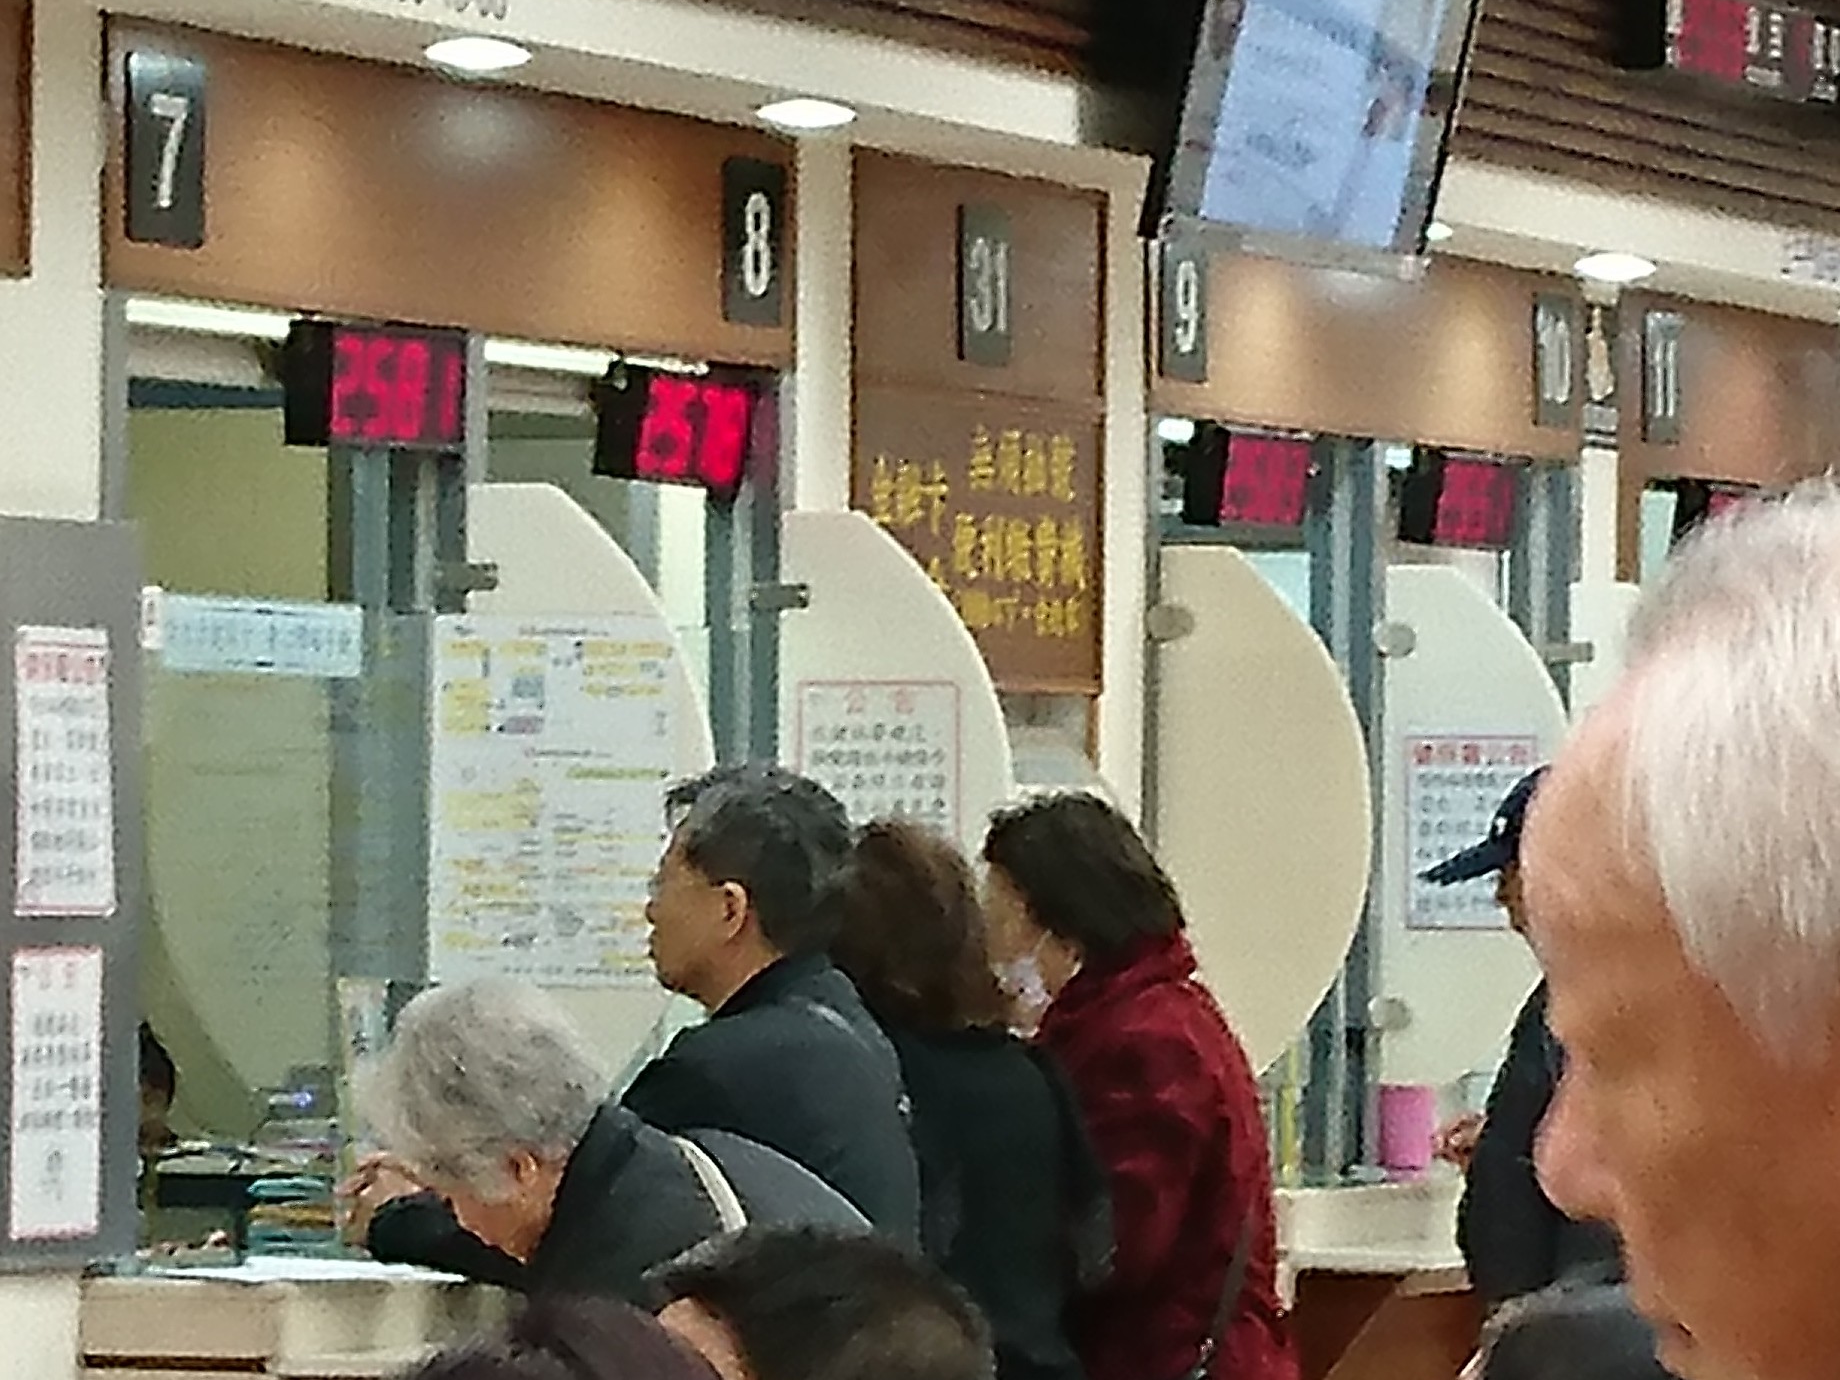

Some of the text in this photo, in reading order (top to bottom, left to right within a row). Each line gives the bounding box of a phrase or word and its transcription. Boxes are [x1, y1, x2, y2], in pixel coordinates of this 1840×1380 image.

[151, 93, 190, 212] 7
[742, 192, 773, 300] 8
[967, 234, 1010, 336] 31
[1173, 260, 1198, 355] 9
